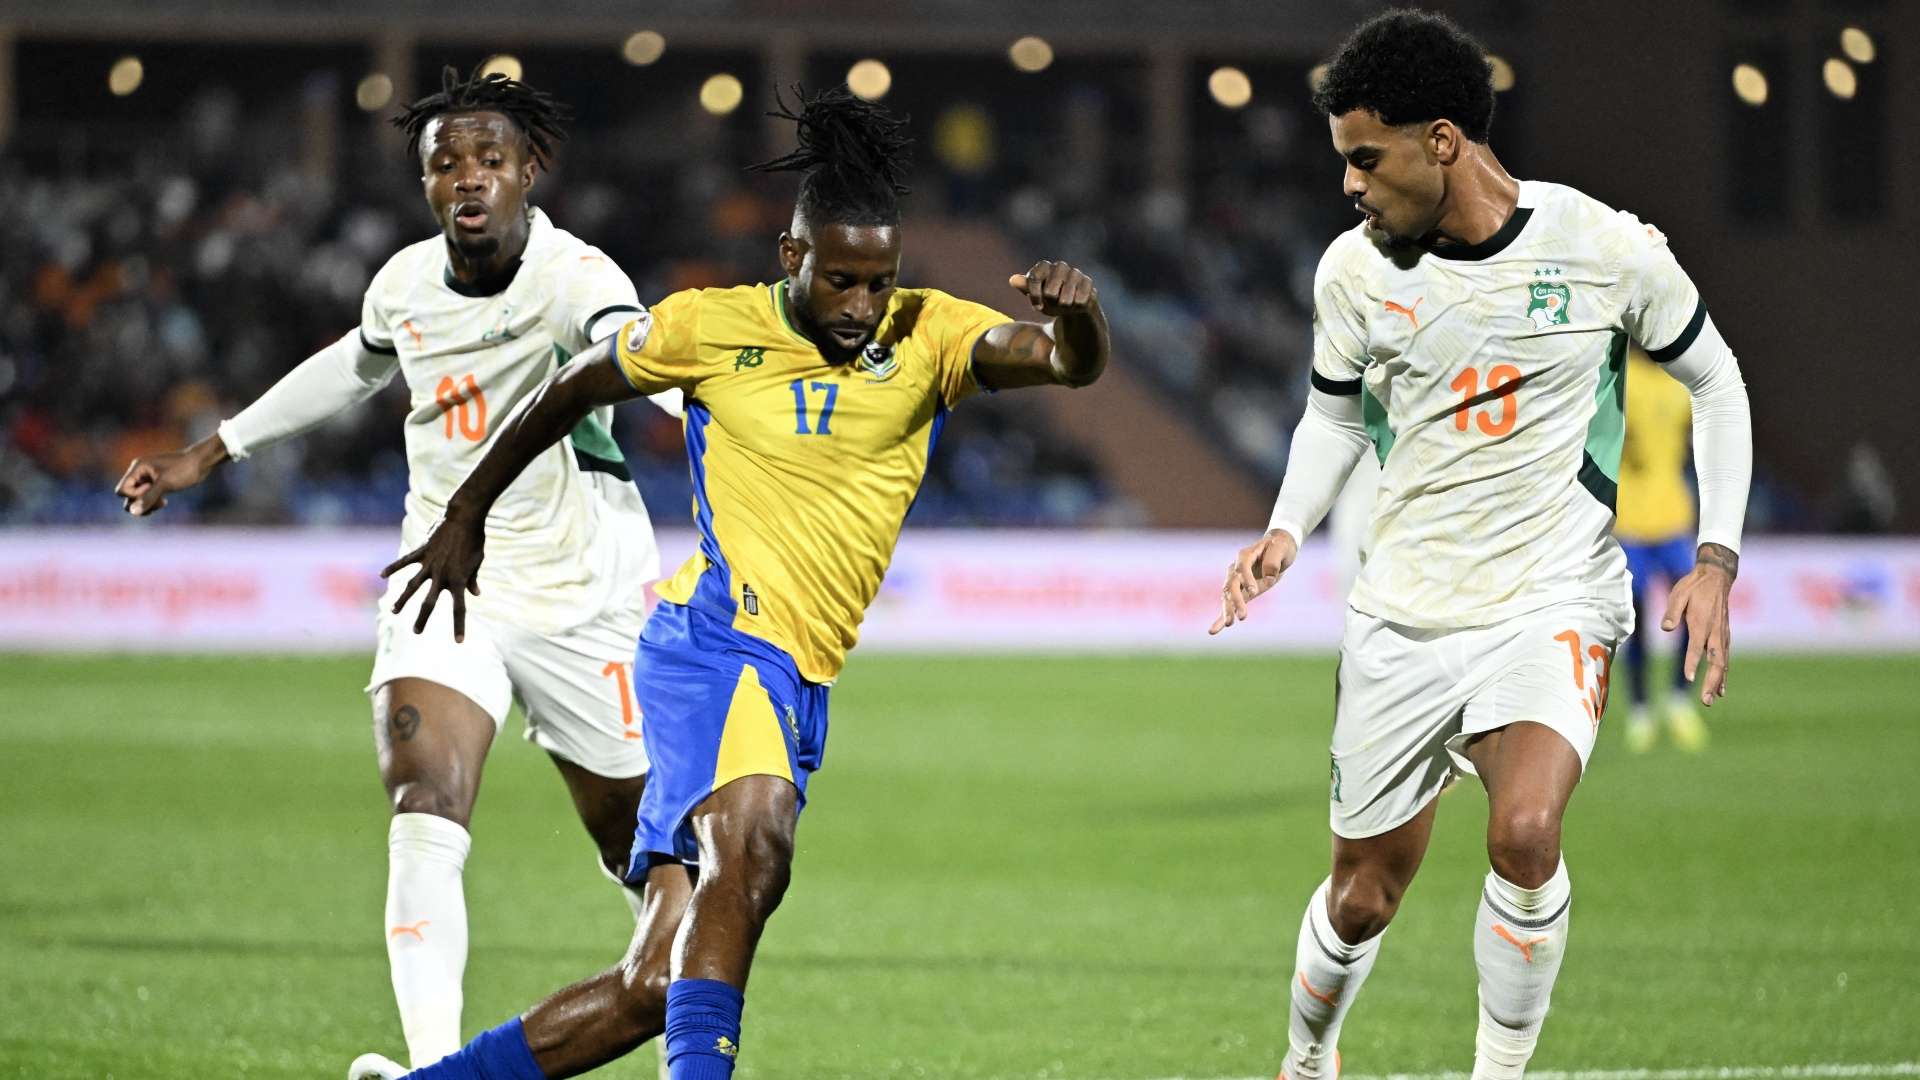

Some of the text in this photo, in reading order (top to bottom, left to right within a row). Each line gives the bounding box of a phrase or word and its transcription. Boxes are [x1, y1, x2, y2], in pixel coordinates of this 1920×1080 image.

[436, 374, 487, 441] 10
[789, 378, 839, 435] 17
[1451, 364, 1521, 437] 13
[603, 661, 642, 739] 1
